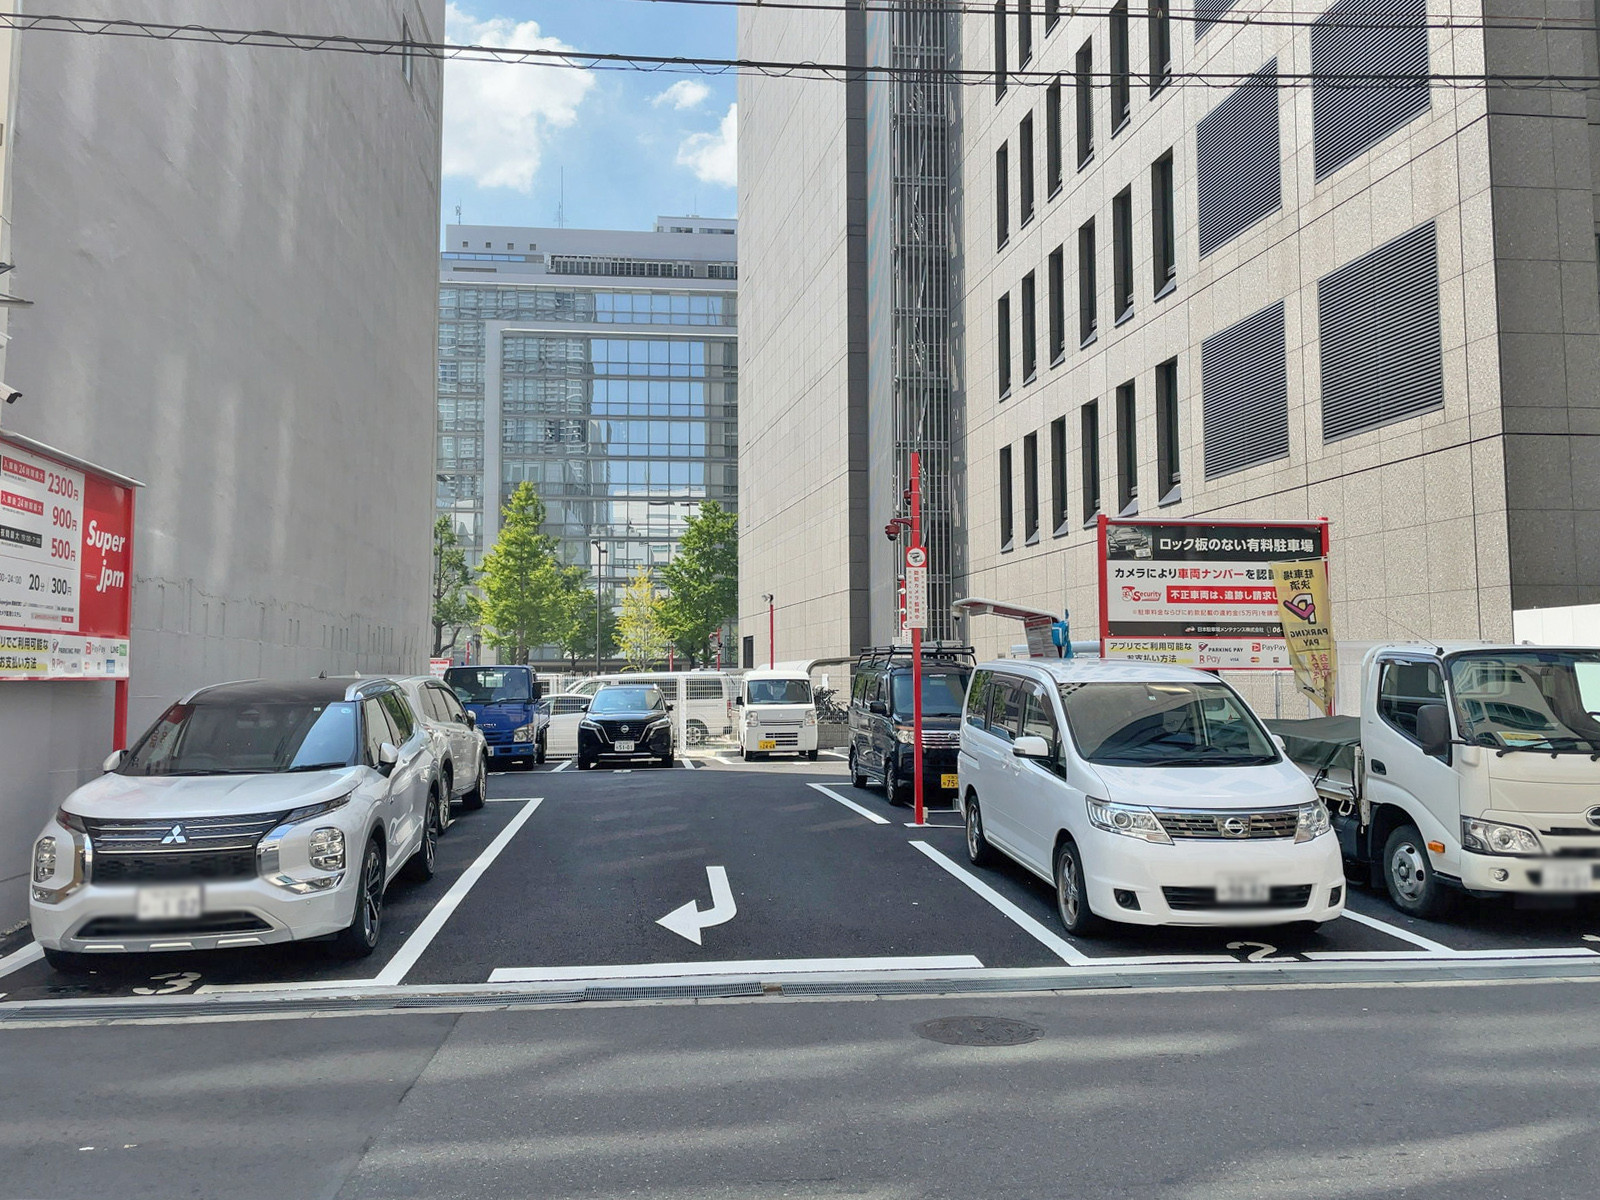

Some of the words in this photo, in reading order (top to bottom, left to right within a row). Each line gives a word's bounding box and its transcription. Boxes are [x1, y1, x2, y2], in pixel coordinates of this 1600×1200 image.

[48, 473, 79, 501] 2300円
[52, 506, 77, 531] 900円
[86, 519, 125, 556] Super
[1160, 538, 1314, 553] ロック板のない有料駐車場
[51, 538, 76, 562] 500円
[51, 578, 72, 596] 300円
[96, 559, 124, 593] jpm
[1132, 590, 1162, 601] Security
[1110, 642, 1192, 651] アプリでご利用可能な
[1226, 941, 1300, 963] 2
[132, 971, 202, 995] 3
